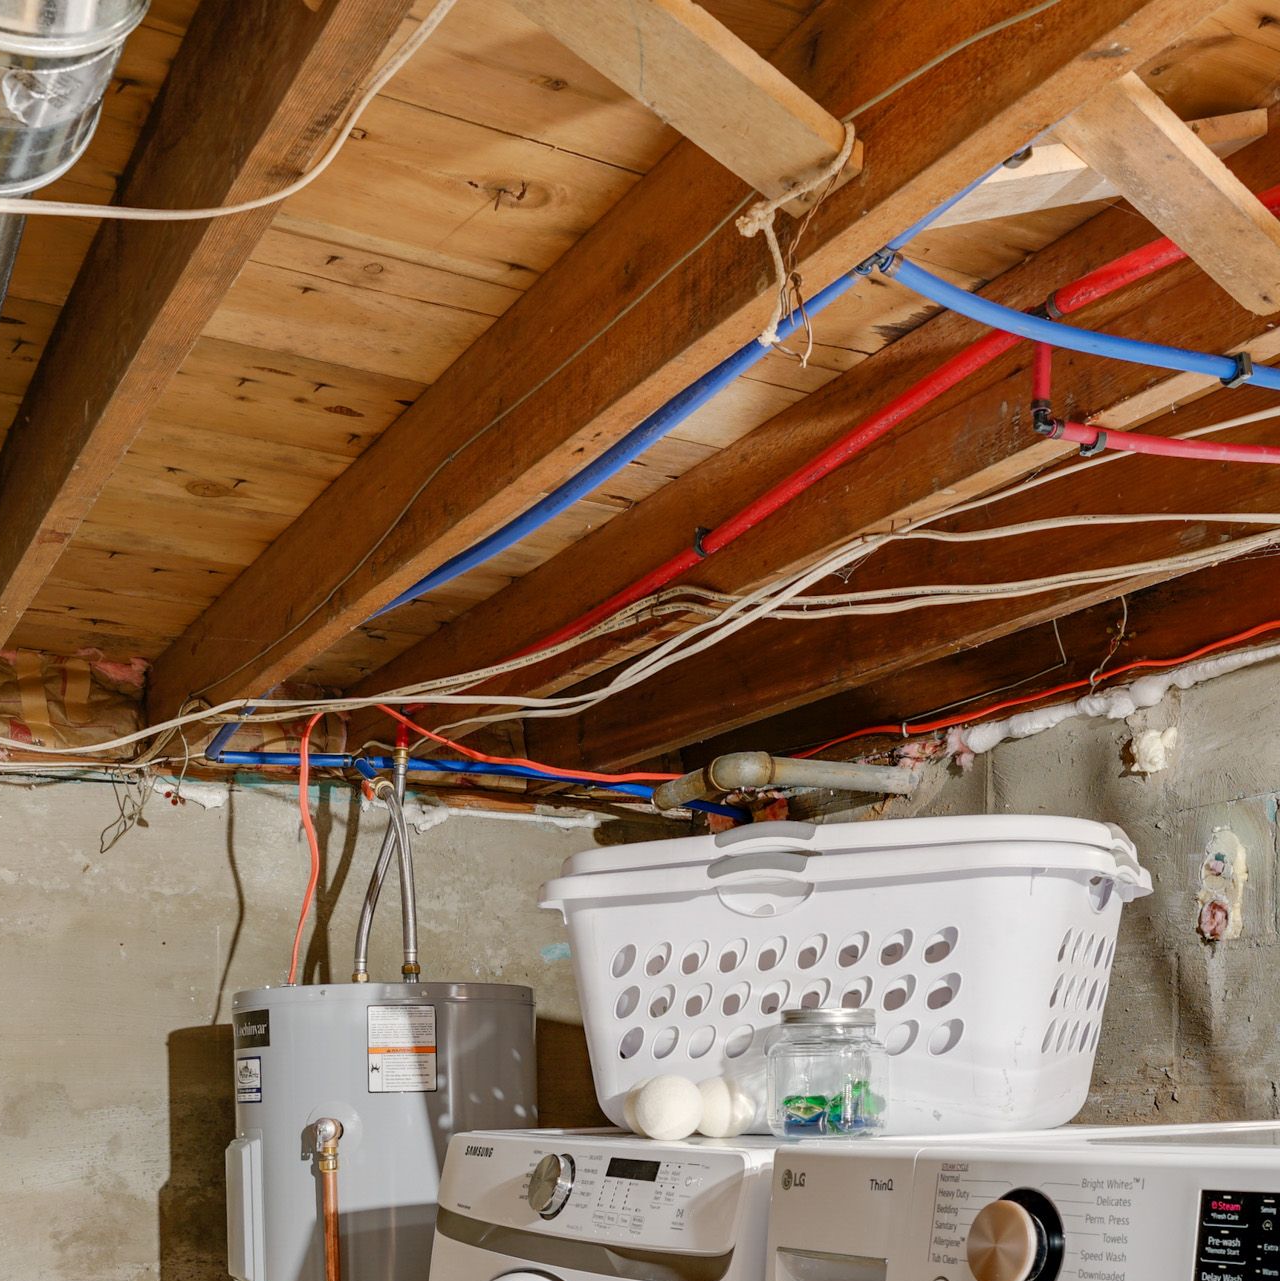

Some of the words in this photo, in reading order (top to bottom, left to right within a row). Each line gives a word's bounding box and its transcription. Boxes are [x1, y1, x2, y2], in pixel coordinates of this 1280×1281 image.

[465, 1145, 493, 1158] SAMSUNG
[793, 1172, 806, 1187] LG
[941, 1174, 960, 1183] Normal
[870, 1178, 893, 1191] ThinQ
[1081, 1178, 1104, 1192] Bright
[939, 1189, 955, 1198] Heavy
[956, 1190, 969, 1199] Duty
[1096, 1196, 1131, 1207] Delicates
[1218, 1201, 1240, 1211] Steam
[937, 1204, 958, 1216] Bedding
[1108, 1214, 1129, 1226] Press
[935, 1221, 957, 1232] Sanitary
[1103, 1233, 1128, 1244] Towels
[1208, 1236, 1240, 1247] Pre-wash
[1080, 1249, 1103, 1261] Speed
[1106, 1252, 1127, 1262] Wash
[1227, 1248, 1240, 1256] Start
[932, 1253, 941, 1263] Tub
[942, 1254, 958, 1264] Clean
[1078, 1269, 1125, 1281] Downloaded
[1262, 1268, 1279, 1276] Warm
